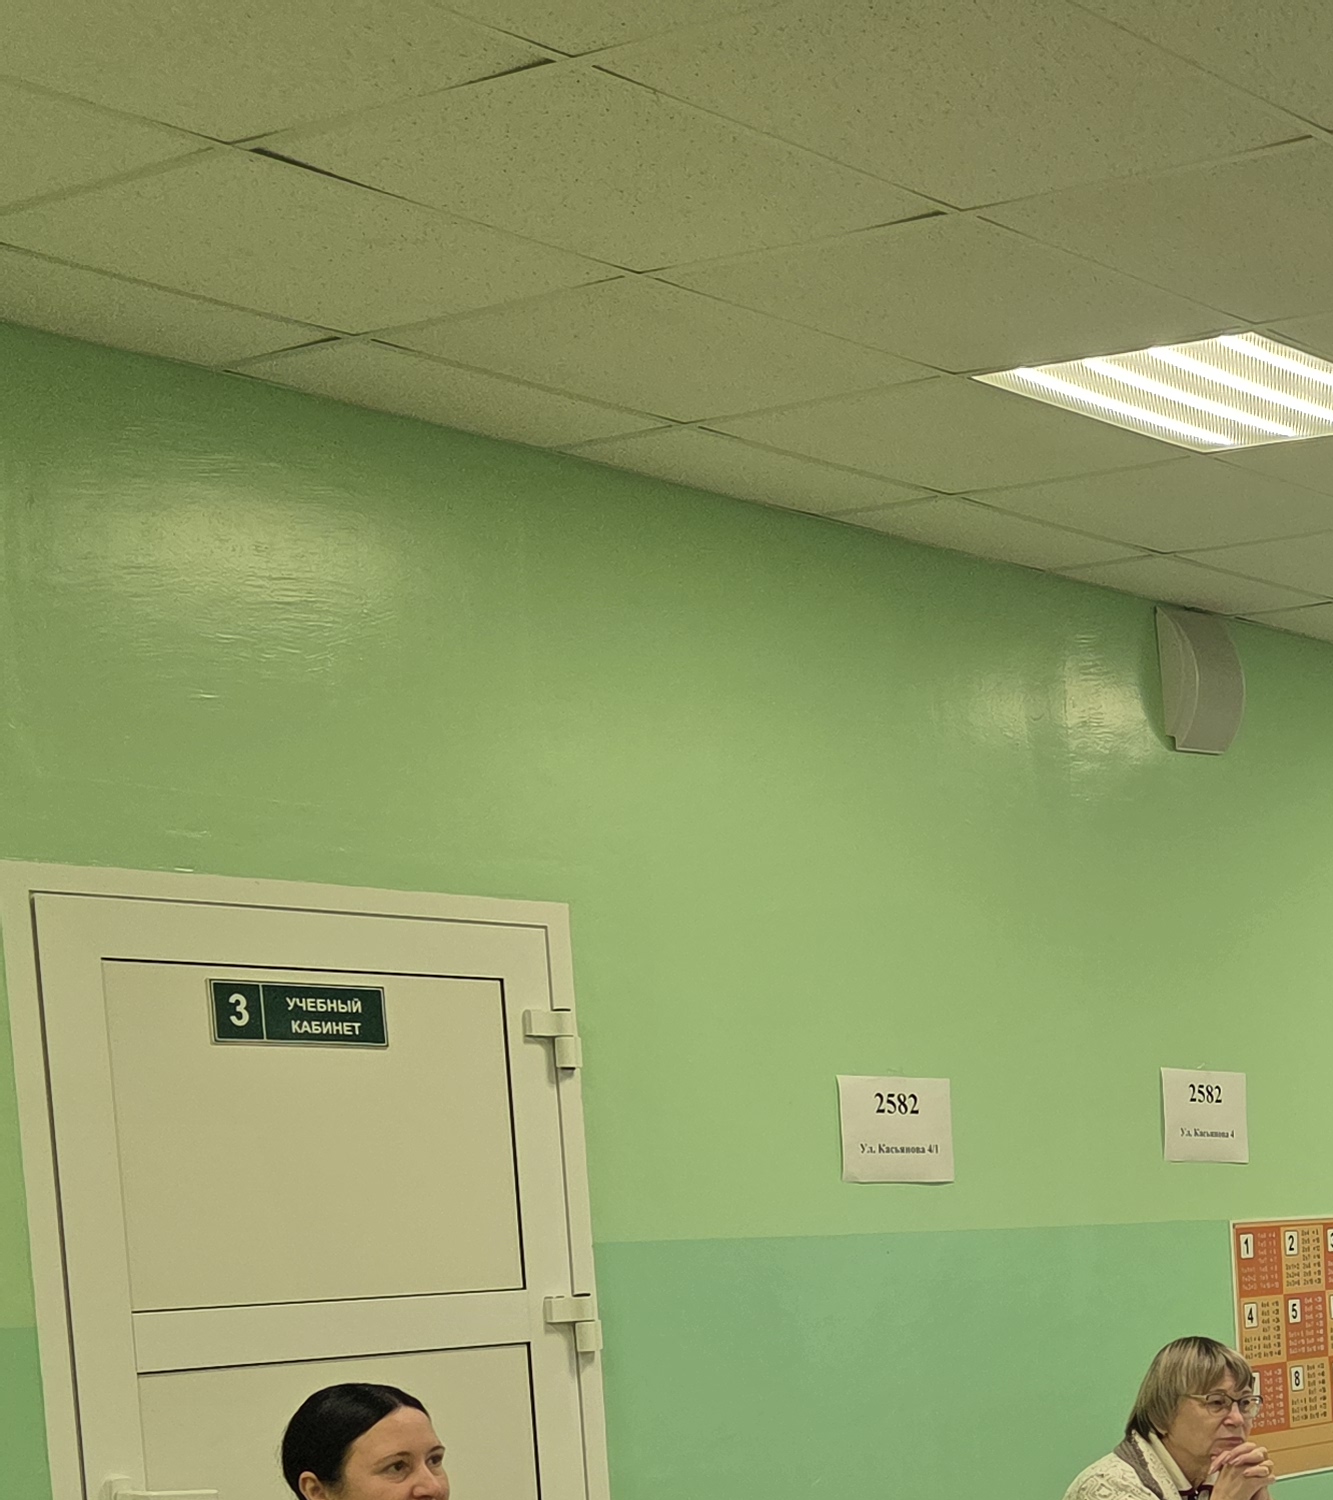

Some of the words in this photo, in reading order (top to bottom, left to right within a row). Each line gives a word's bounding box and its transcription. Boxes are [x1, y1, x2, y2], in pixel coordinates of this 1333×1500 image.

[228, 992, 250, 1027] 3
[285, 996, 362, 1013] УЧЕБНЫЙ
[291, 1020, 362, 1035] КАБИНЕТ
[1188, 1083, 1223, 1104] 2582
[874, 1092, 920, 1115] 2582
[859, 1143, 876, 1154] Ул.
[878, 1143, 926, 1154] Касьянова
[1243, 1237, 1249, 1255] 1
[1288, 1234, 1295, 1251] 2
[1247, 1306, 1254, 1323] 4
[1291, 1303, 1298, 1319] 5
[1294, 1370, 1300, 1387] 8
